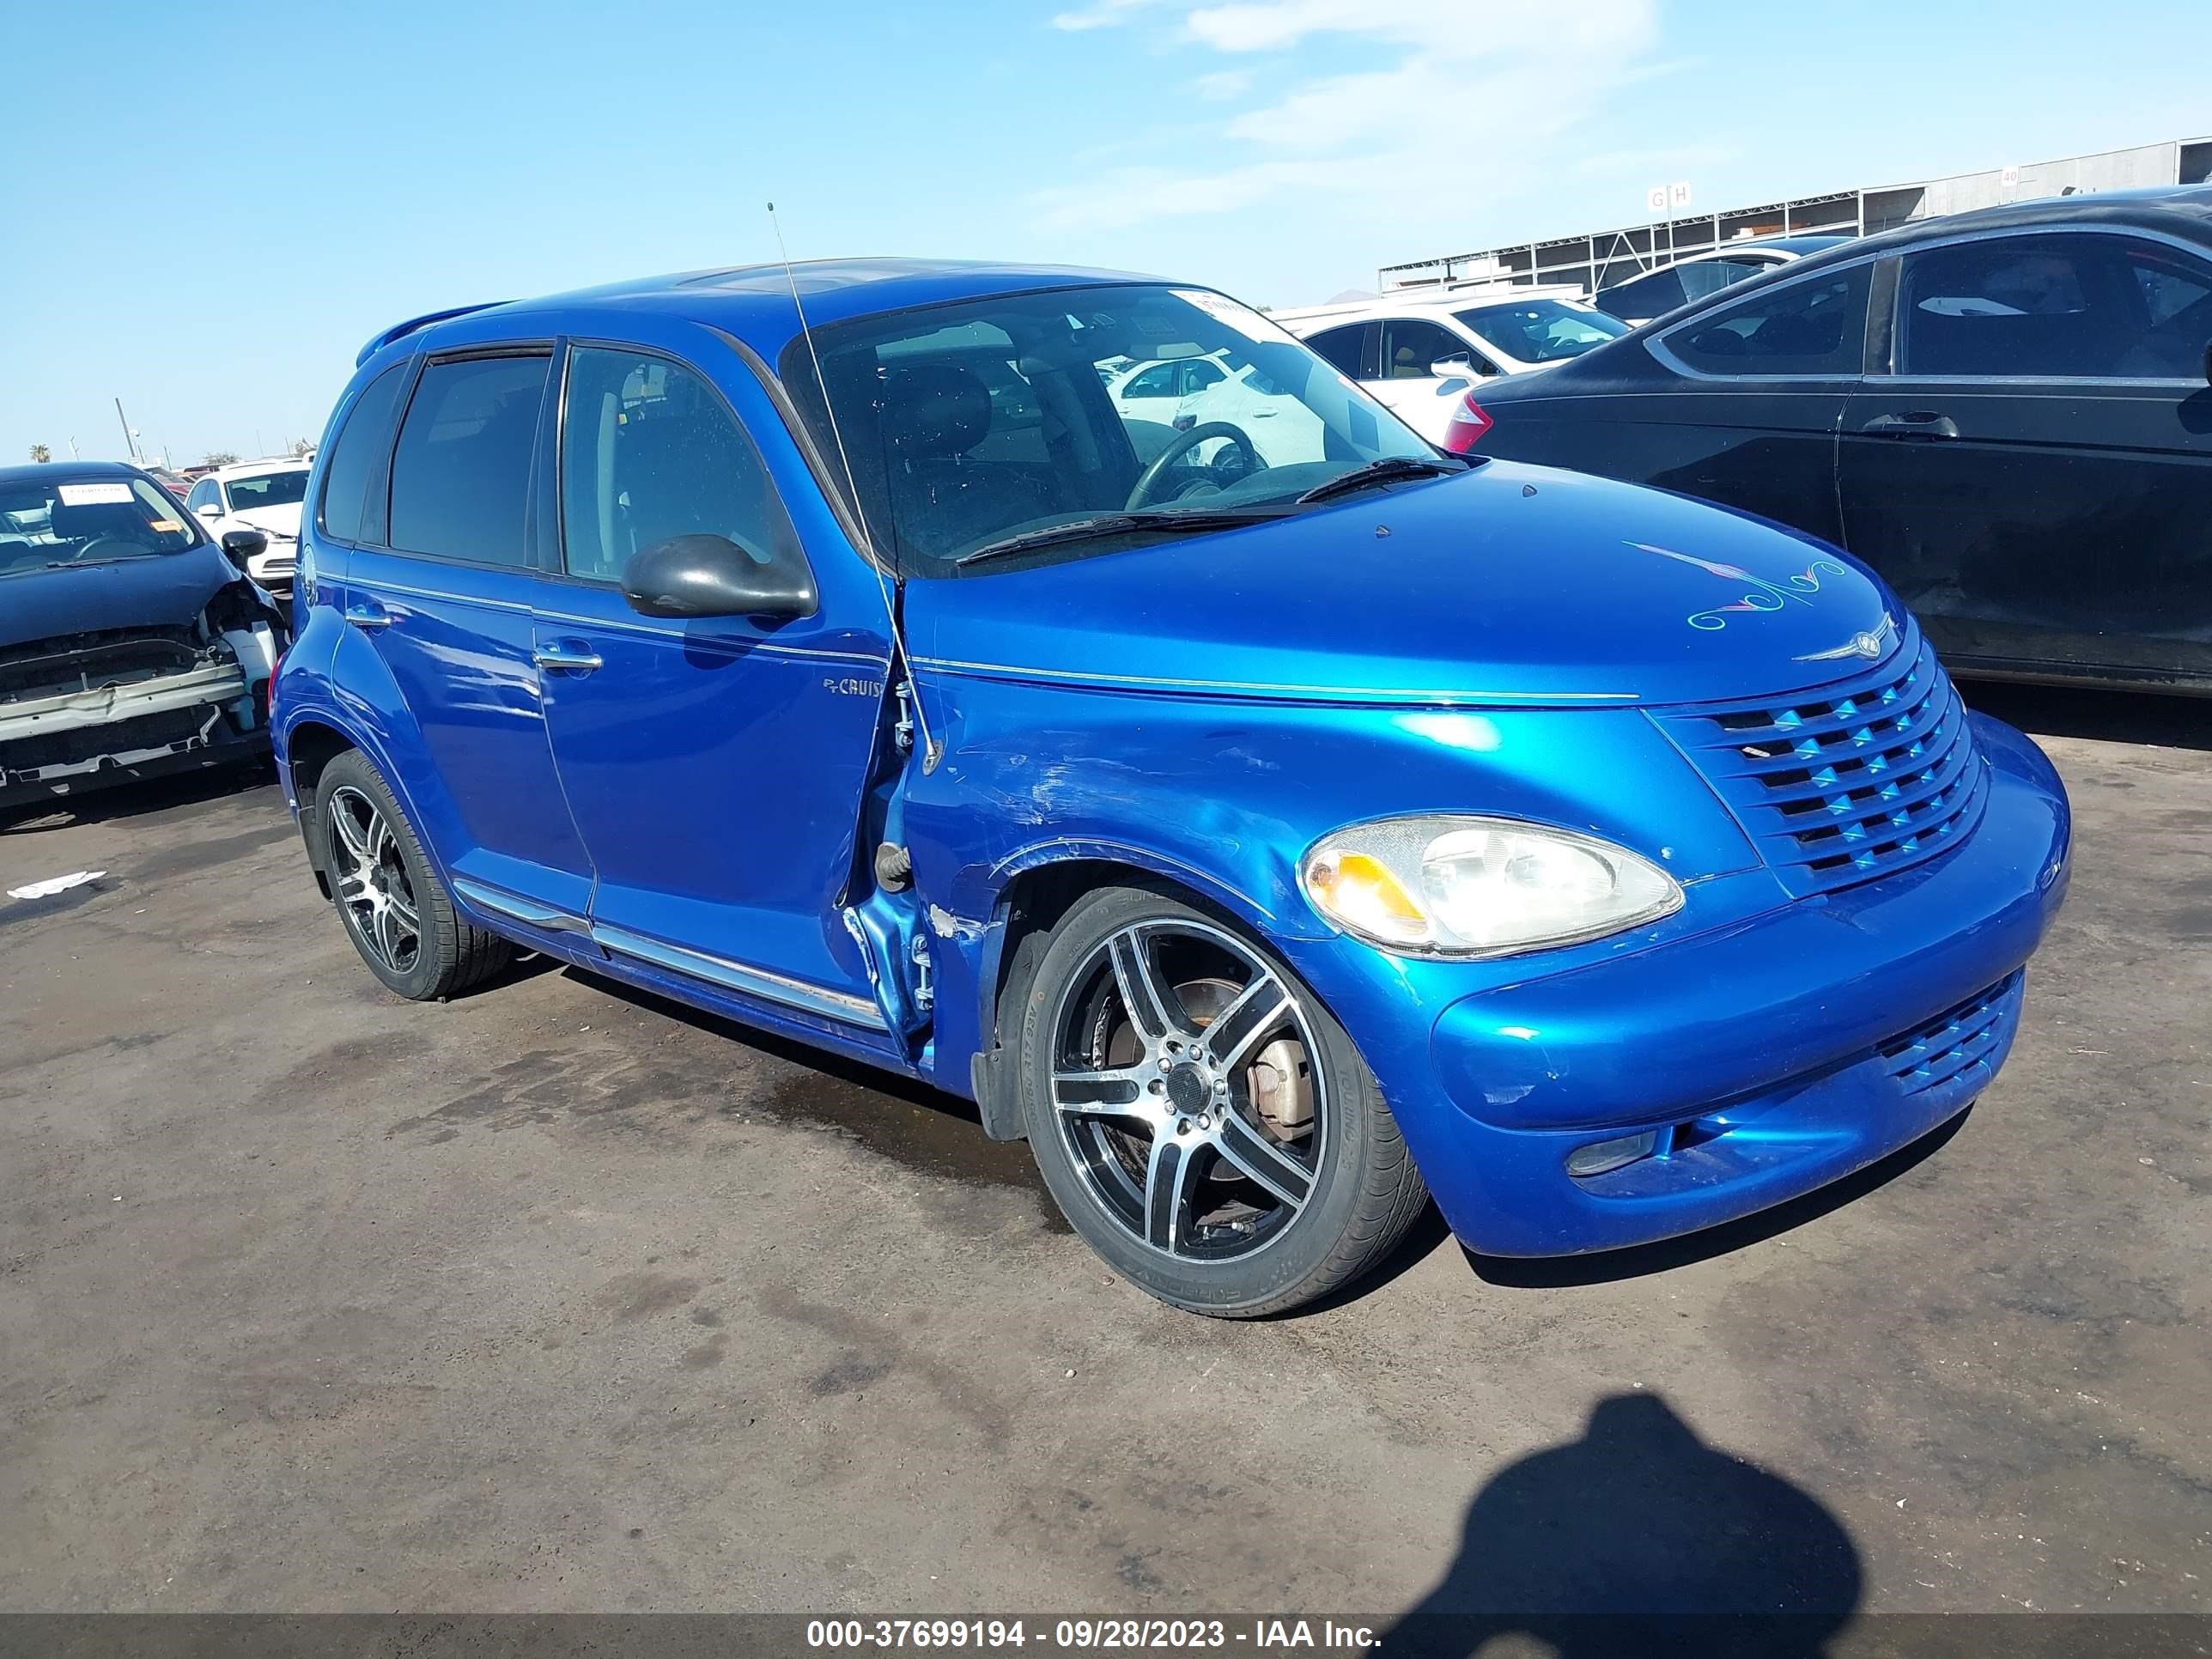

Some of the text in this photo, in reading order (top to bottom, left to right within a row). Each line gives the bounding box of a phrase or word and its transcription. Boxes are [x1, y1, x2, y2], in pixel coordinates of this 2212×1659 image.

[2002, 171, 2018, 181] 40
[1652, 191, 1664, 207] G
[1675, 185, 1686, 202] H
[1025, 1004, 1037, 1038] 93V
[1339, 1067, 1356, 1143] TOURING
